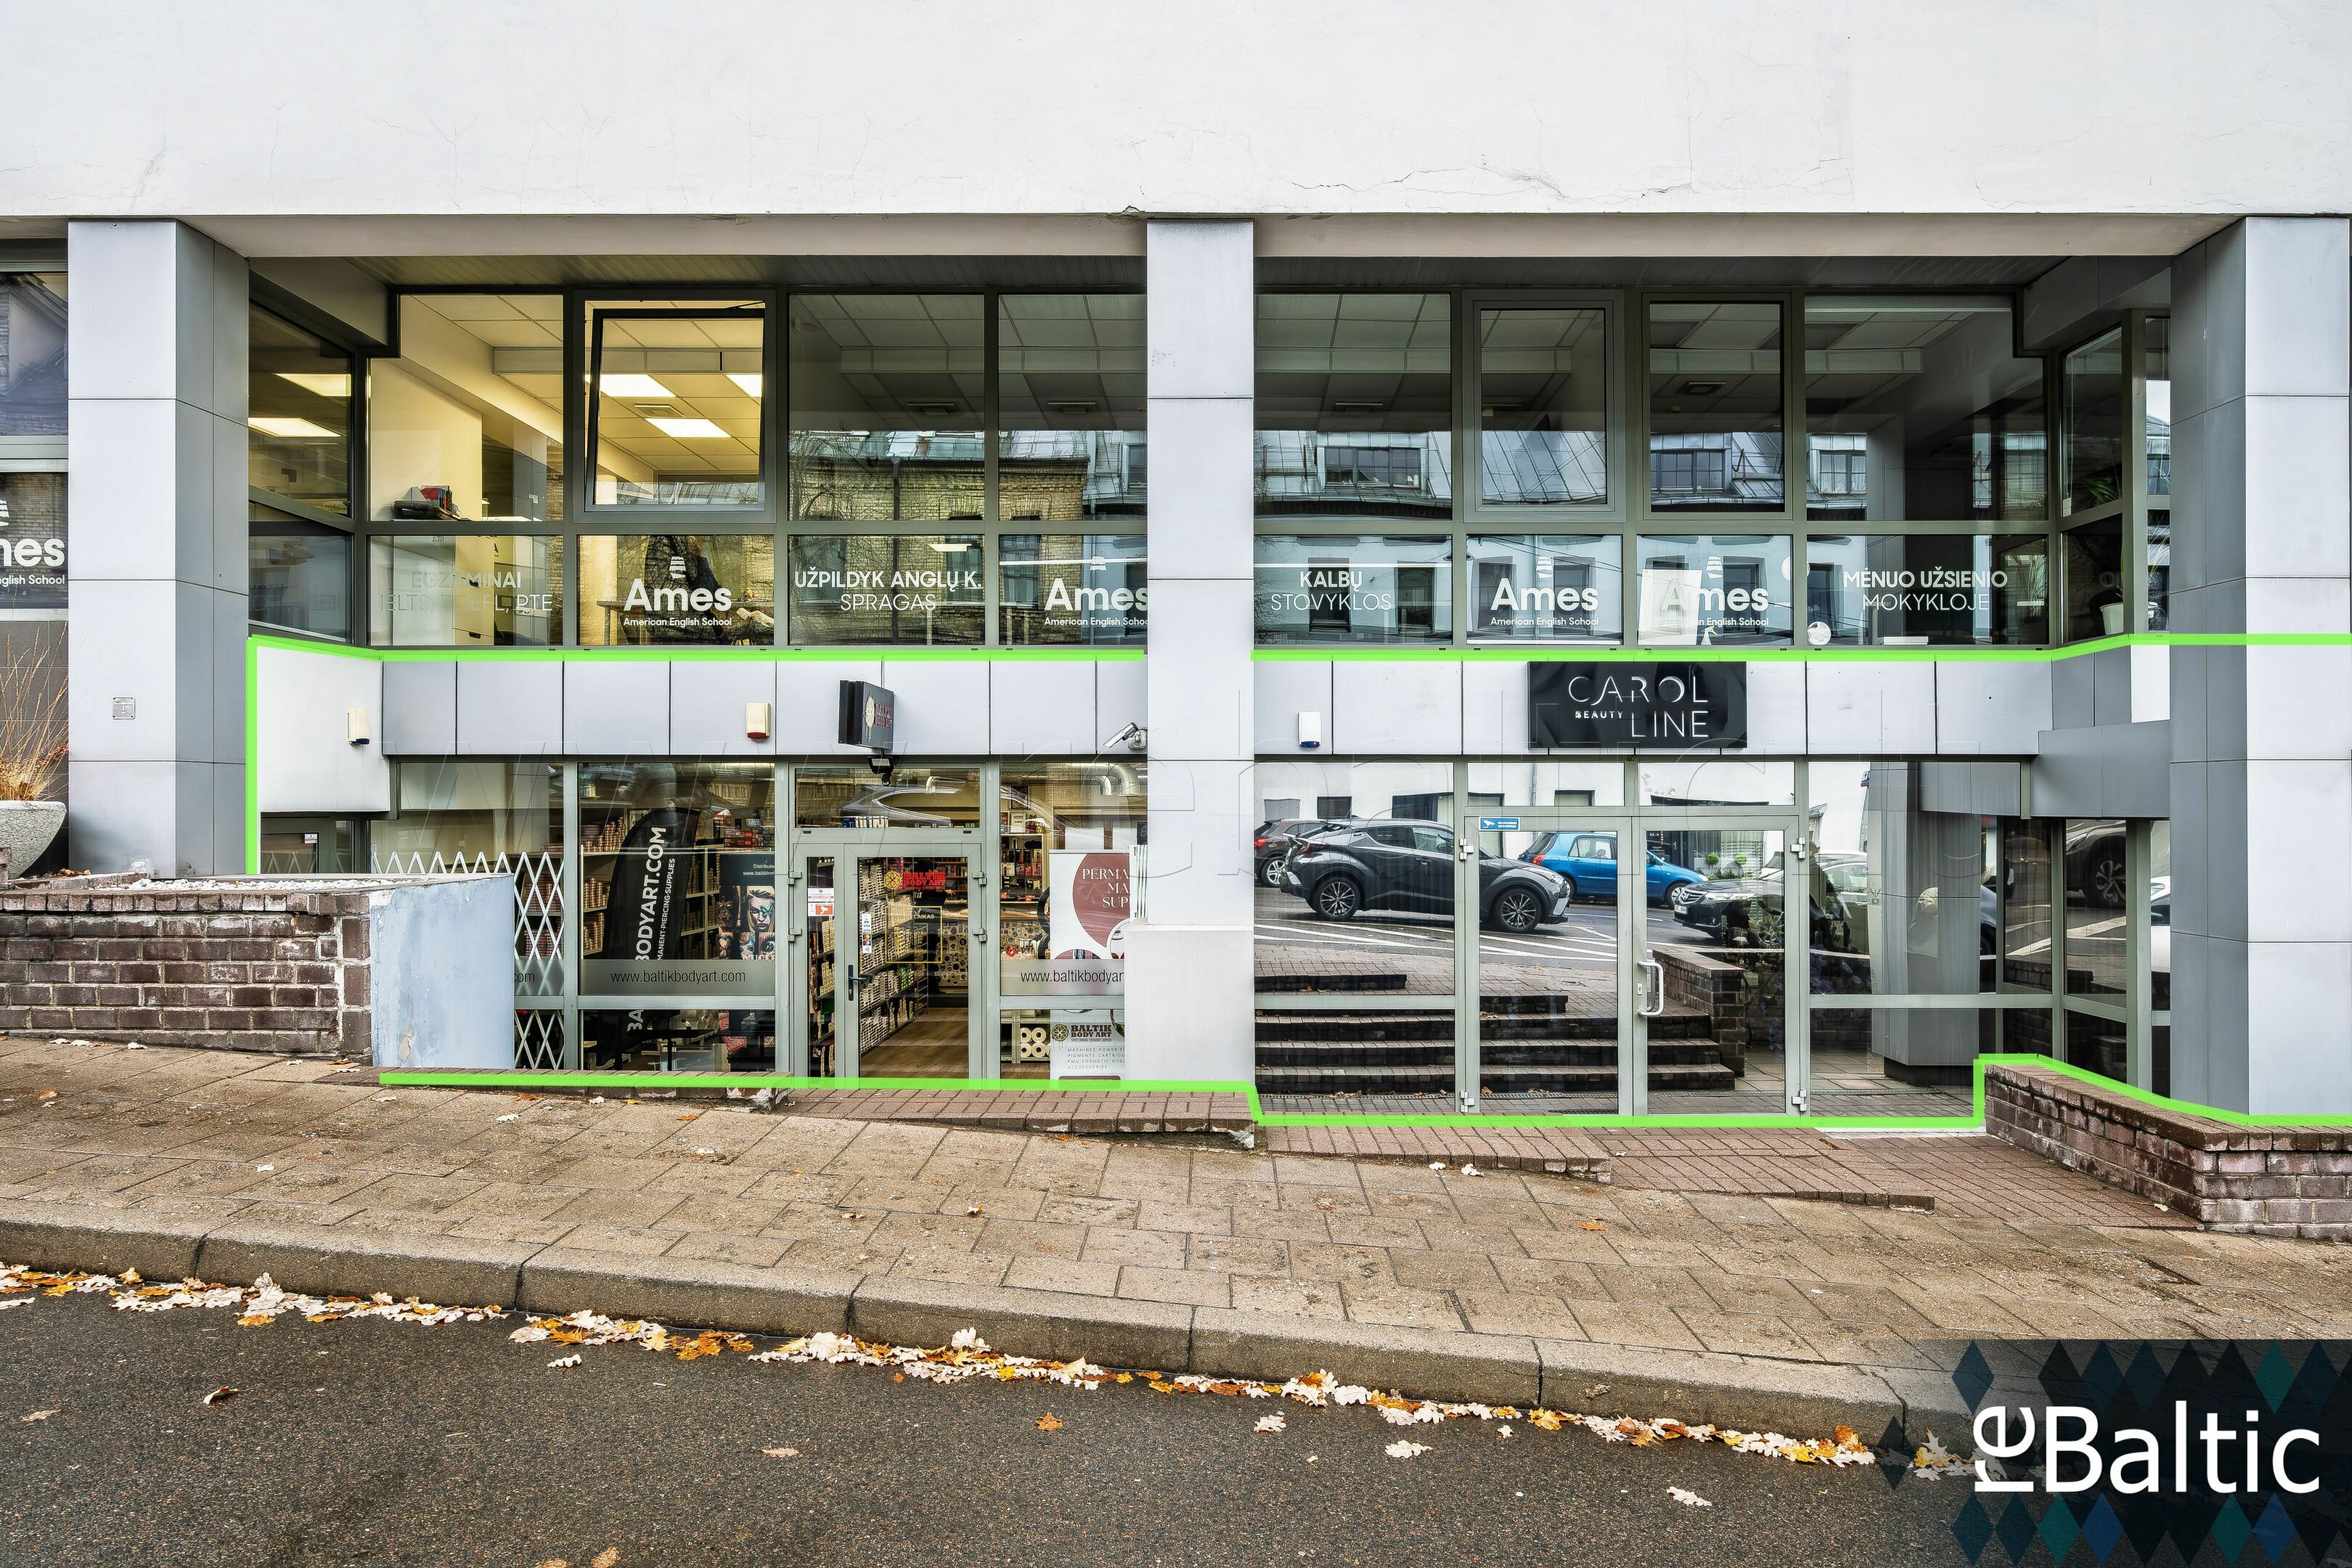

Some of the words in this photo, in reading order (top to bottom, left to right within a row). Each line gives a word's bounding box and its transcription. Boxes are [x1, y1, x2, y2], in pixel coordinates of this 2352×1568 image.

[0, 575, 25, 587] glish
[28, 575, 65, 584] School
[412, 571, 521, 588] EGZAMINAI
[794, 567, 885, 588] UŽPILDYK
[891, 571, 957, 592] ANGLŲ
[964, 571, 982, 588] K.
[1299, 571, 1363, 592] KALBŲ
[1844, 567, 1914, 588] MĖNUO
[1920, 566, 2007, 588] UŽSIENIO
[516, 594, 552, 611] PTE
[624, 579, 732, 611] Ames
[840, 593, 936, 611] SPRAGAS
[1045, 578, 1147, 611] Ames
[1270, 593, 1392, 611] STOVYKLOS
[1490, 578, 1599, 611] Ames
[1661, 579, 1769, 611] Ames
[1863, 593, 1990, 611] MOKYKLOJE
[669, 618, 700, 628] English
[1090, 617, 1120, 627] English
[1537, 618, 1567, 627] English
[1707, 618, 1736, 627] English
[1568, 676, 1708, 706] CAROL
[1575, 710, 1623, 719] BEAUTY
[1631, 711, 1708, 737] LINE
[1082, 868, 1129, 880] PERMA
[1108, 882, 1129, 894] MA
[1102, 897, 1130, 907] SUP
[611, 970, 746, 985] www.baltikbodyart.com
